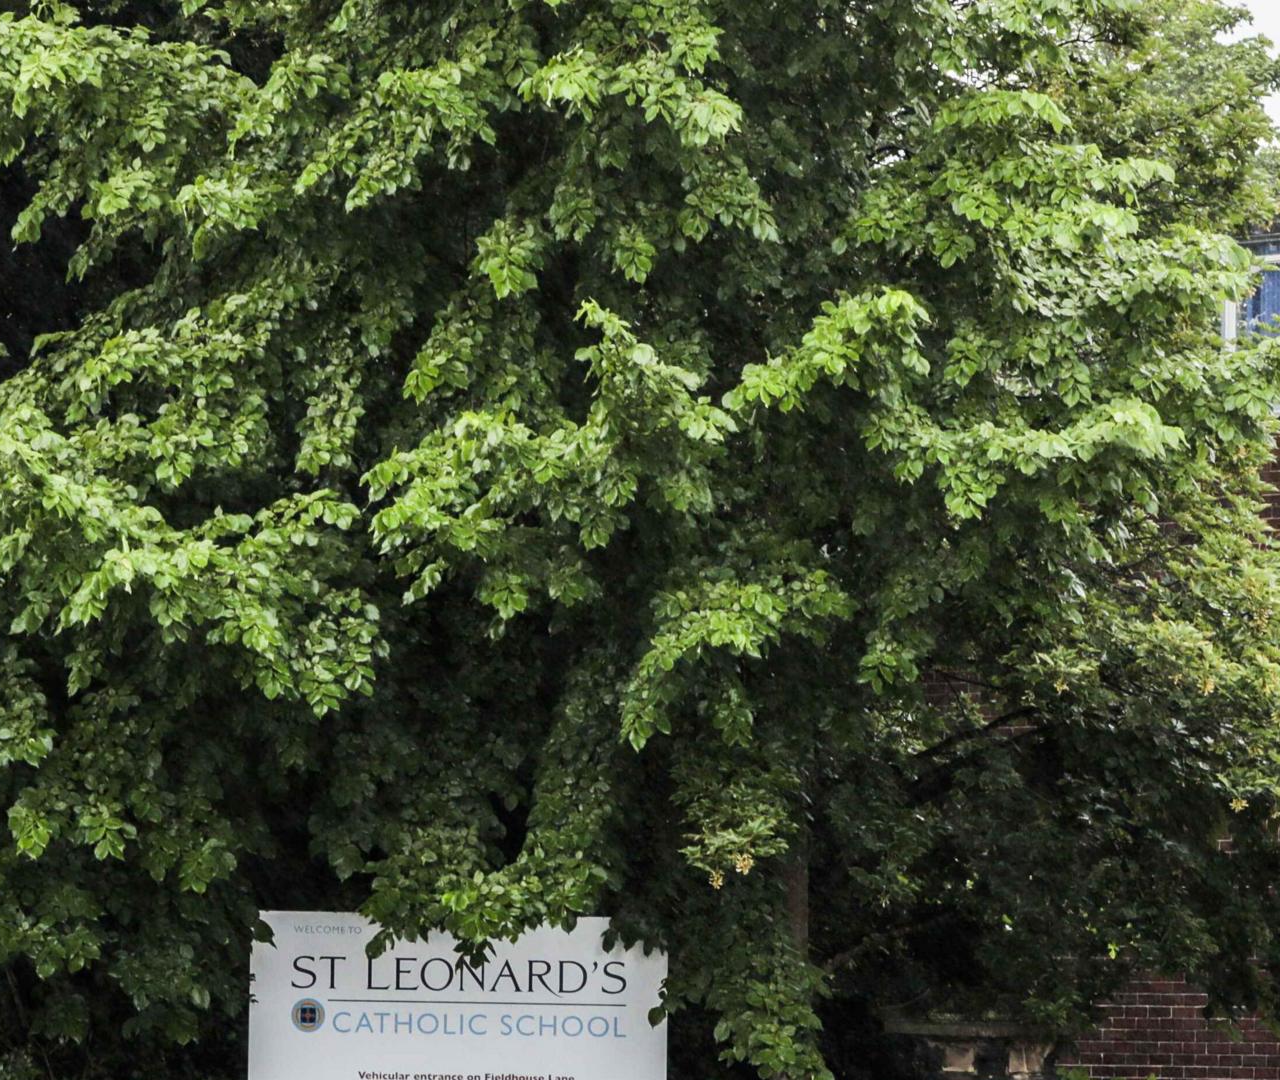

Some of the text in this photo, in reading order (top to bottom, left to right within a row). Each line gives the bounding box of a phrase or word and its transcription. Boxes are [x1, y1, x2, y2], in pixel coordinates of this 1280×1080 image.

[293, 925, 362, 935] WELCOME TO
[290, 955, 628, 998] ST LEONARD'S
[332, 1011, 627, 1038] CATHOLIC SCHOOL
